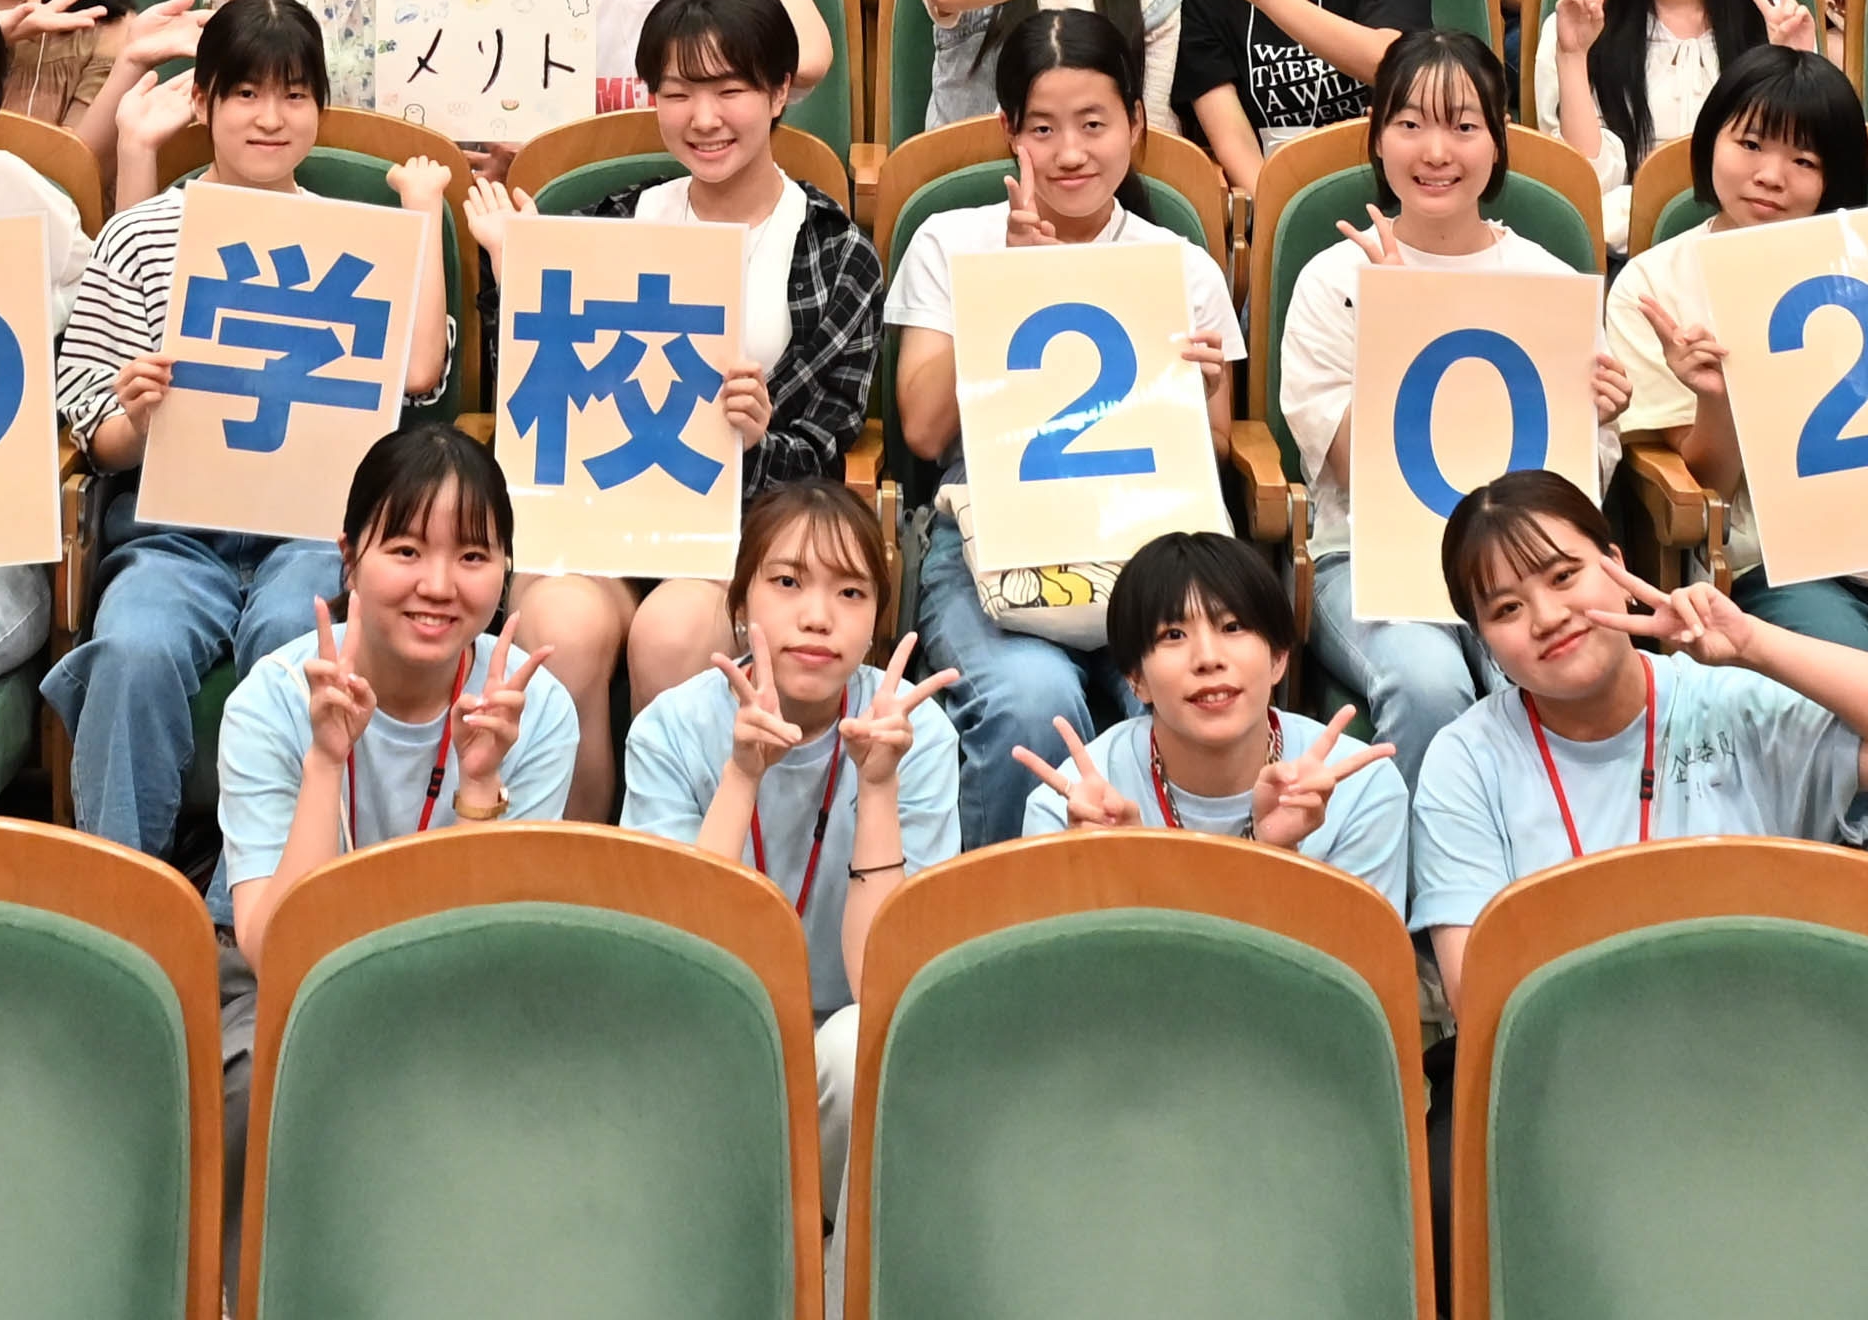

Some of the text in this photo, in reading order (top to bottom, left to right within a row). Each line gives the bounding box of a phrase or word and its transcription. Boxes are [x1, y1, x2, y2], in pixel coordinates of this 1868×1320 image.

[406, 27, 576, 94] メリト
[1266, 89, 1288, 113] A
[171, 241, 392, 454] 学
[506, 268, 725, 495] 校
[1006, 303, 1156, 482] 2
[1393, 329, 1549, 520] 0
